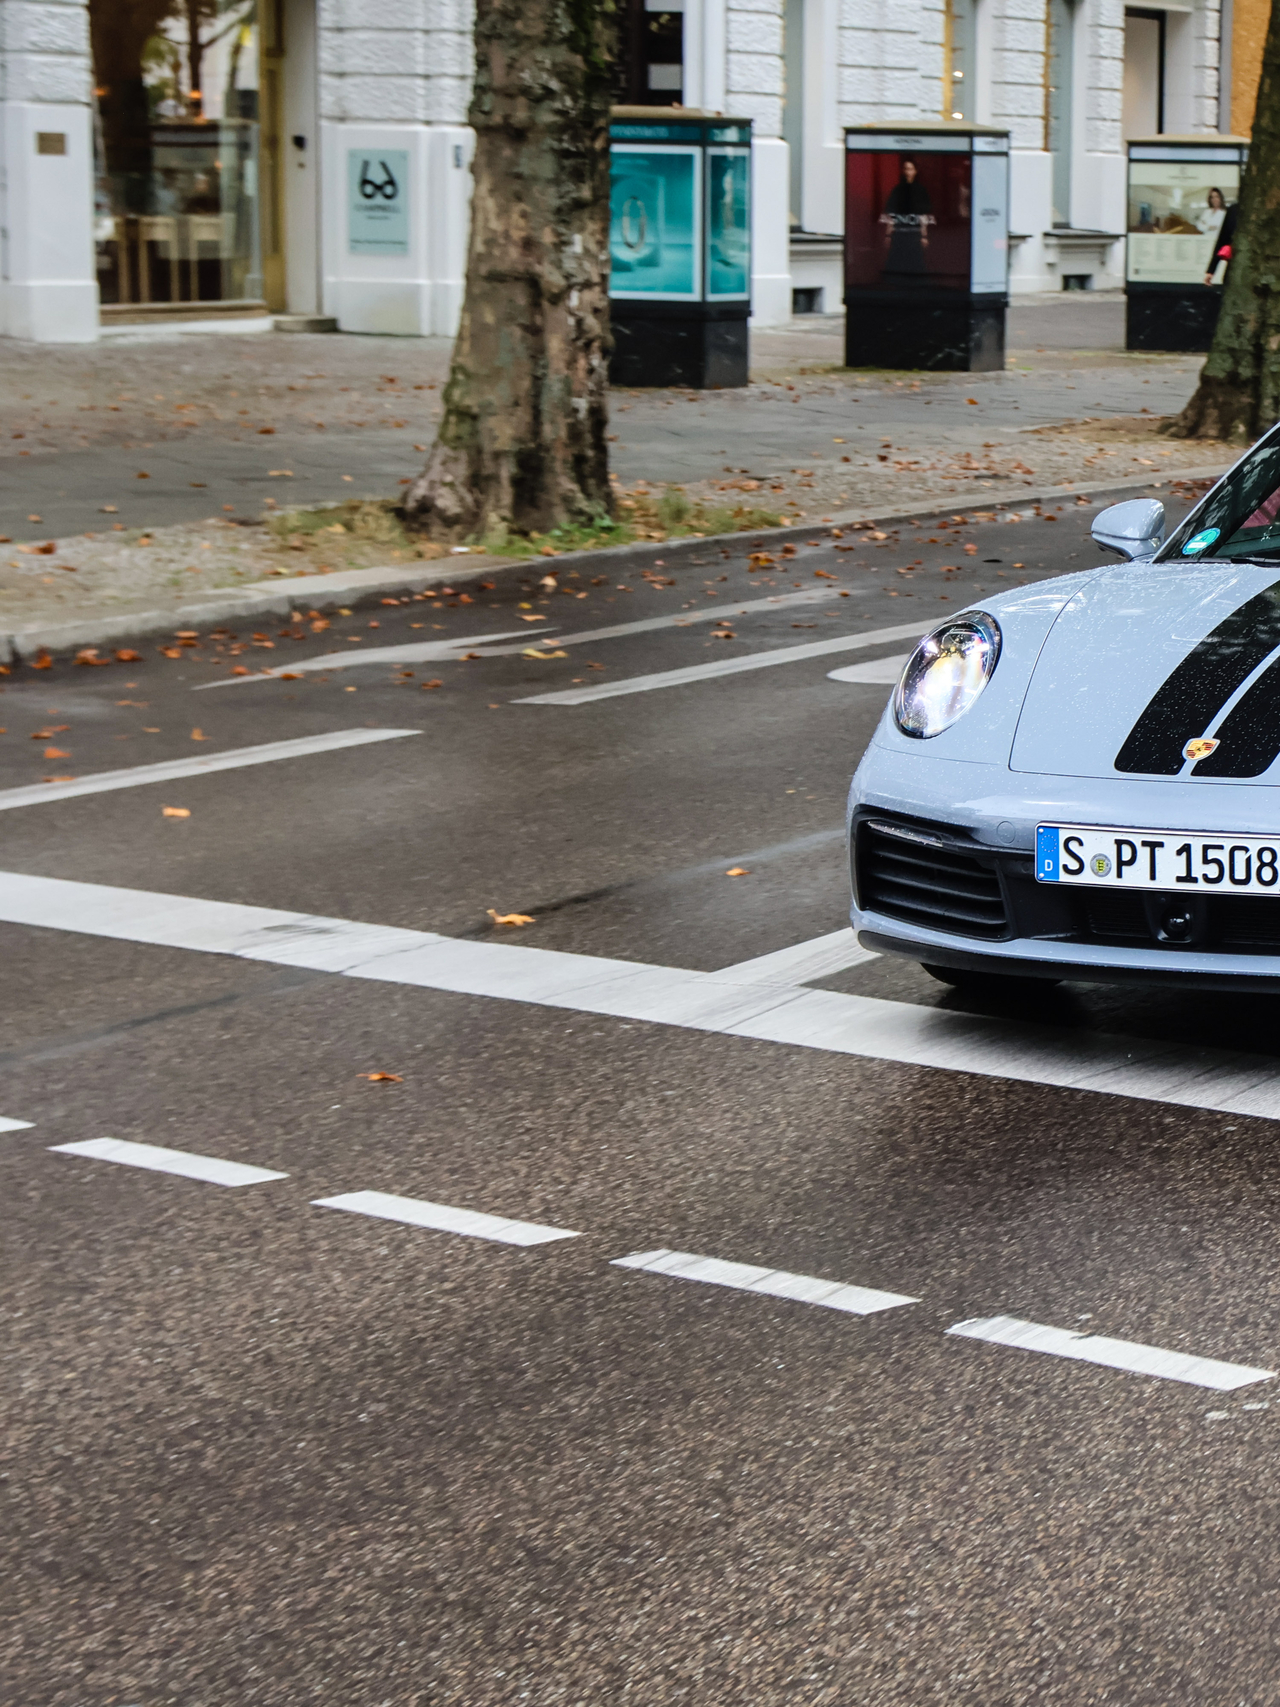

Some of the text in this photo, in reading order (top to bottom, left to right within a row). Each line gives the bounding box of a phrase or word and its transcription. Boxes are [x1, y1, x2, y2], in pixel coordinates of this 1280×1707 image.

[1044, 836, 1279, 887] D S PT 1508
